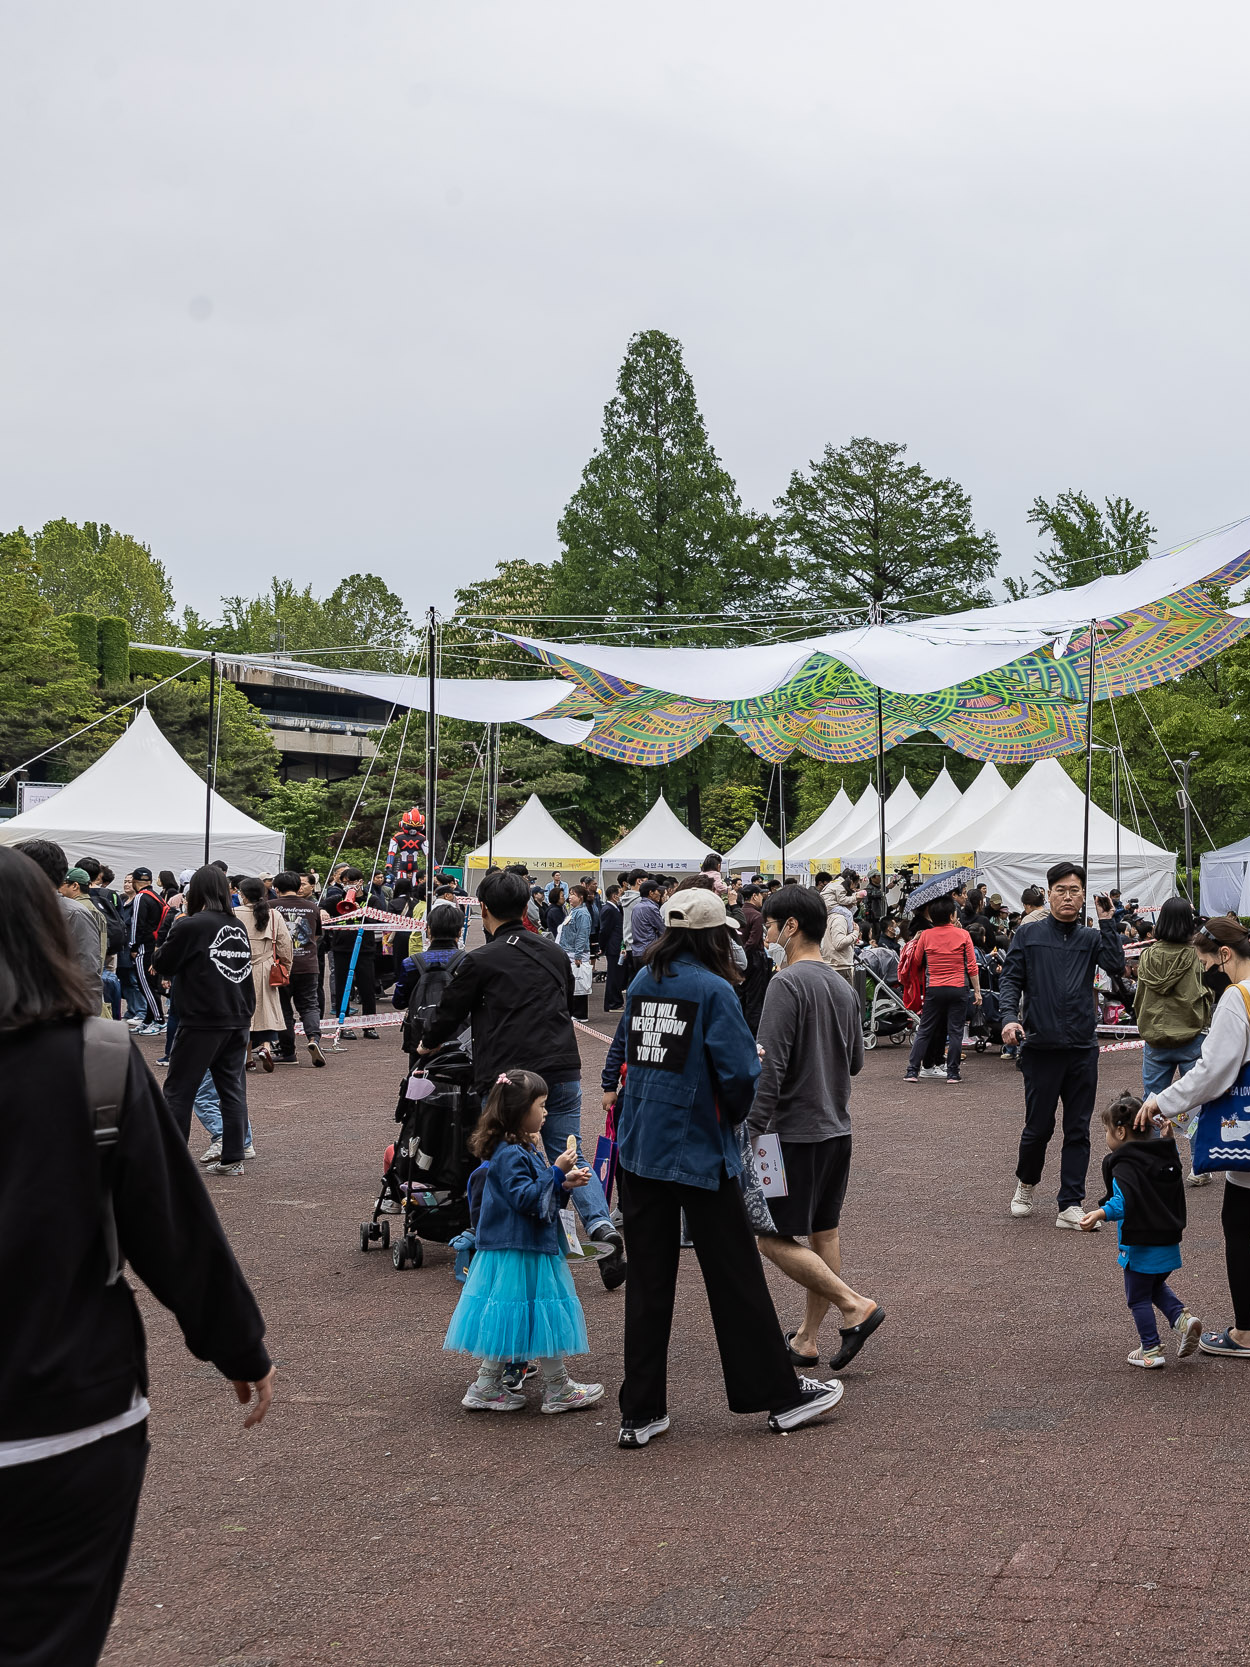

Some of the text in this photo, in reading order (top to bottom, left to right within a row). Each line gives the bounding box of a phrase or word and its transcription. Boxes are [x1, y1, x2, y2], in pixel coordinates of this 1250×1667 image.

[209, 948, 251, 959] Pregoner
[641, 1002, 678, 1019] YOU WILL
[632, 1016, 687, 1036] NEVER KNOW
[642, 1032, 662, 1046] UNTIL
[637, 1045, 668, 1063] YOU TRY
